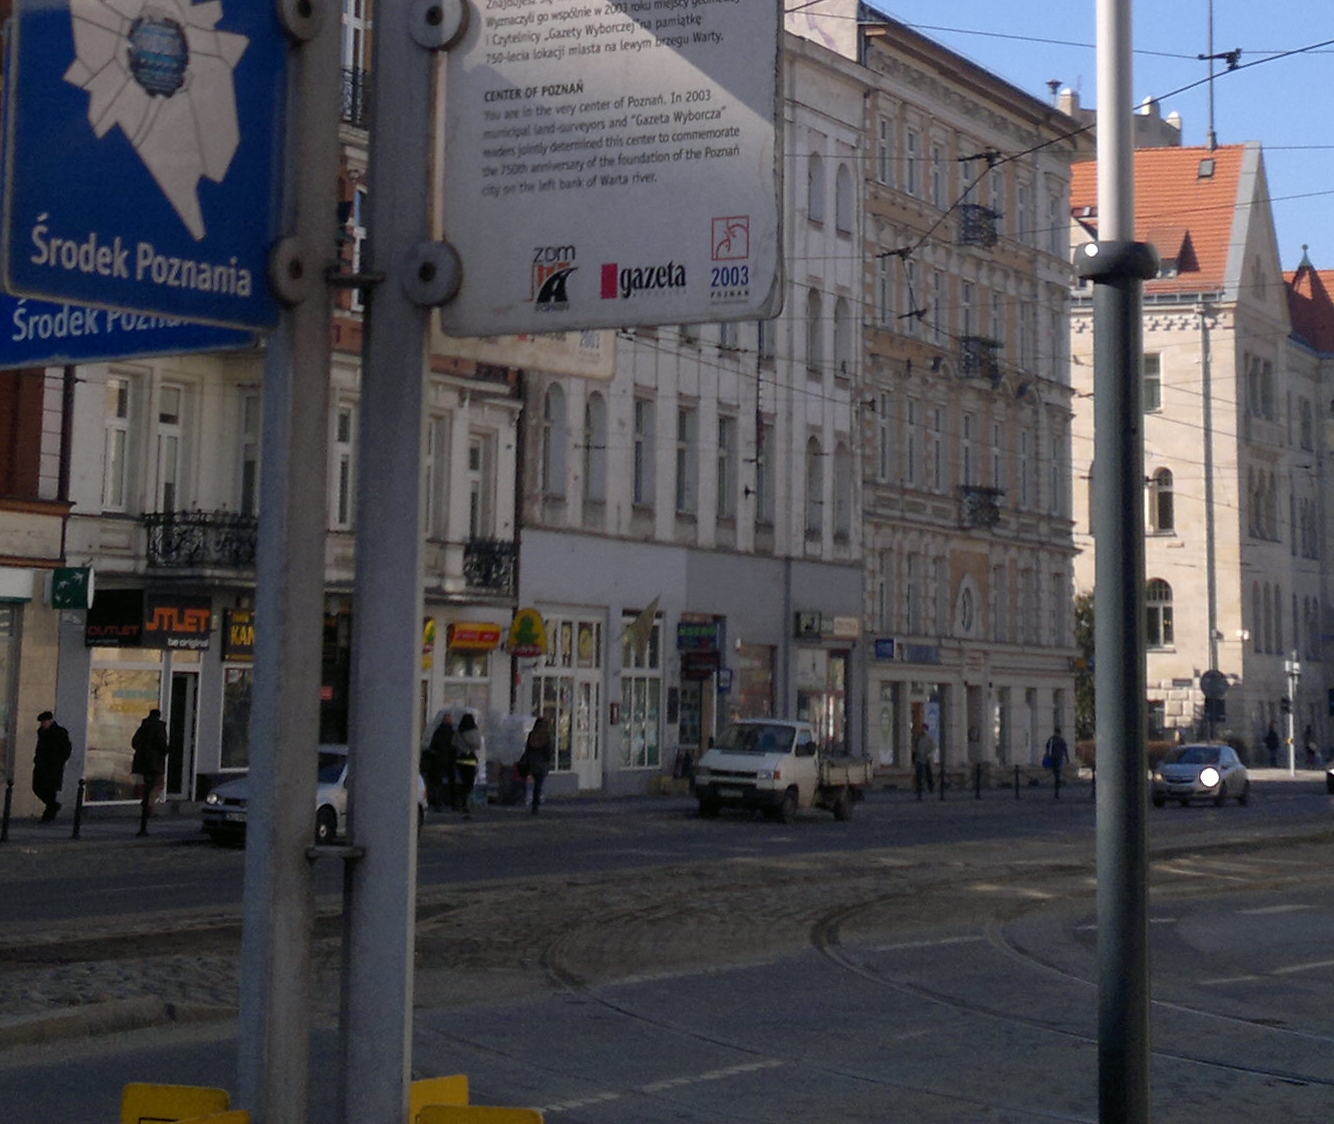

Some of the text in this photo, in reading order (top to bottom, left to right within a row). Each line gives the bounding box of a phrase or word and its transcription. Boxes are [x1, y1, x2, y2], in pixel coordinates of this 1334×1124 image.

[538, 15, 550, 25] go
[604, 2, 628, 16] 2003
[655, 13, 703, 29] pamiątkę
[485, 31, 725, 64] 750-lecia lokacji miasta na lewym brzegu Warty.
[483, 78, 585, 103] CENTER OF POZNAŃ
[536, 103, 553, 116] the
[556, 104, 577, 116] very
[579, 99, 611, 113] center
[613, 95, 625, 110] of
[627, 93, 667, 109] Poznań.
[671, 91, 683, 104] In
[685, 89, 712, 103] 2003
[609, 117, 628, 128] and
[550, 137, 604, 153] determined
[605, 134, 624, 148] this
[625, 132, 656, 146] center
[658, 131, 669, 143] to
[671, 125, 740, 143] commemorate
[586, 153, 597, 168] of
[599, 154, 616, 167] the
[616, 150, 670, 166] foundation
[672, 148, 684, 162] of
[685, 146, 703, 160] the
[704, 144, 740, 159] Poznań
[519, 181, 536, 193] the
[559, 176, 583, 190] bank
[585, 175, 597, 188] of
[632, 171, 658, 184] river.
[30, 213, 253, 299] Środek Poznania
[619, 260, 687, 299] gazeta
[710, 265, 750, 288] 2003
[12, 296, 100, 342] Środek
